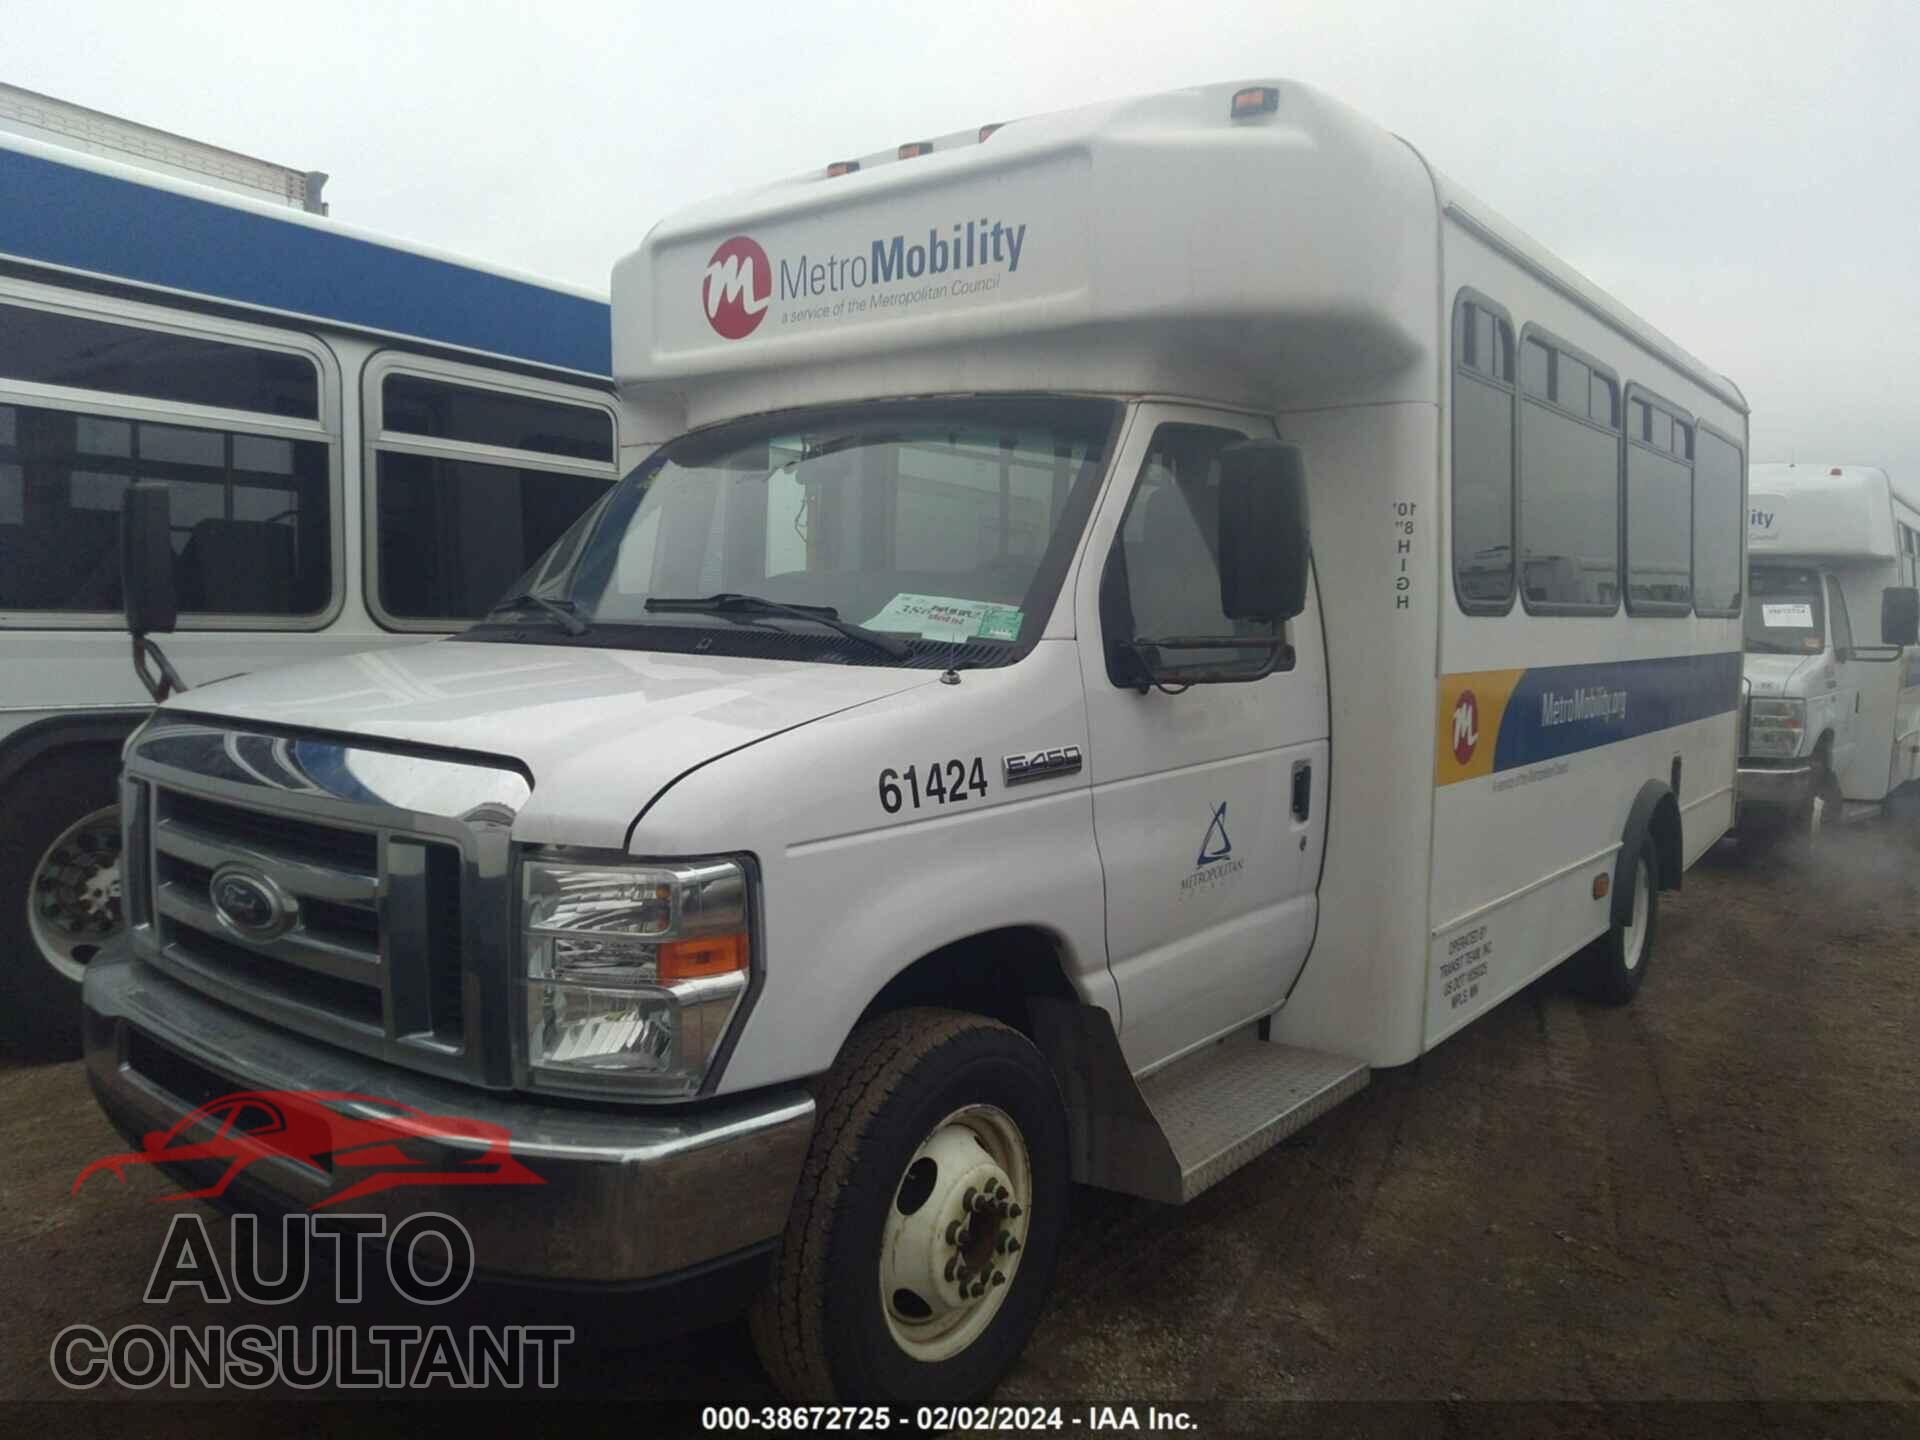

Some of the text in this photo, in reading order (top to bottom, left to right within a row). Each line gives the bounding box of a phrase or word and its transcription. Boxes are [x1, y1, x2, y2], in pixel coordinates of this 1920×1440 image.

[779, 217, 1027, 302] MetroMobility
[781, 273, 1002, 325] a service of the Metropolitan Council
[1541, 686, 1628, 728] MetroMobility.org
[878, 756, 988, 815] 61424
